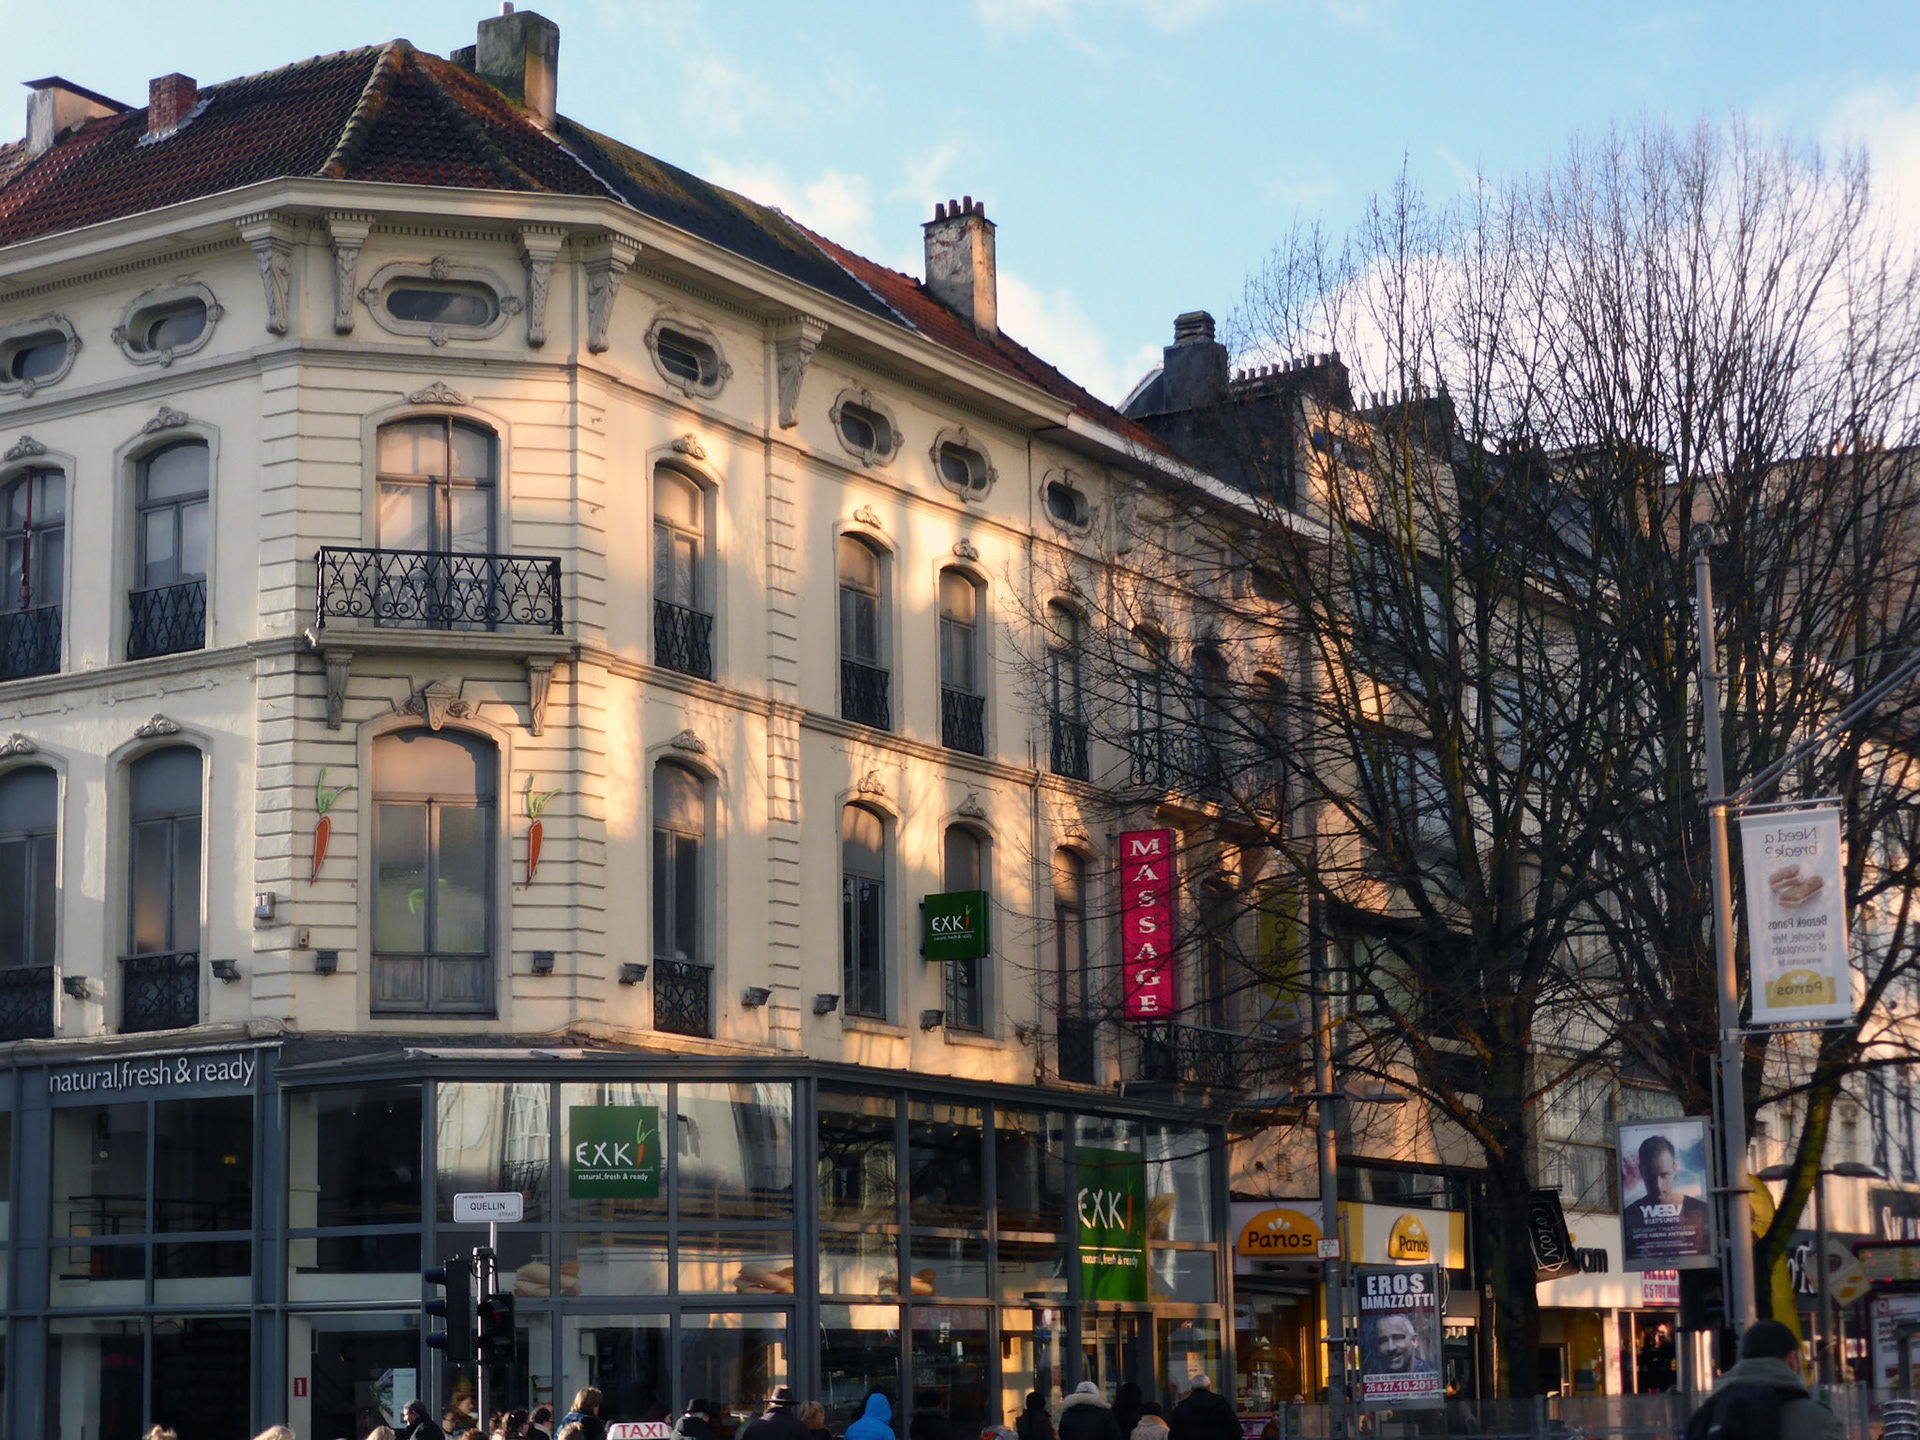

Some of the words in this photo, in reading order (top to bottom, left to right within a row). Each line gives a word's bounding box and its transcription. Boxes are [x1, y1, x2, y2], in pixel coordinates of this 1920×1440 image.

[1129, 837, 1161, 1013] MASSAGE
[175, 1056, 191, 1084] &
[196, 1053, 256, 1087] ready
[630, 1173, 648, 1182] ready
[470, 1202, 506, 1211] QUELLIN
[1249, 1231, 1313, 1249] Panos
[1399, 1234, 1429, 1253] Panos
[1366, 1273, 1425, 1295] EROS
[1361, 1293, 1434, 1310] RAMAZZOTTI
[1366, 1382, 1376, 1392] 26
[1383, 1379, 1438, 1392] 27.10.2015
[617, 1424, 664, 1438] TAXI
